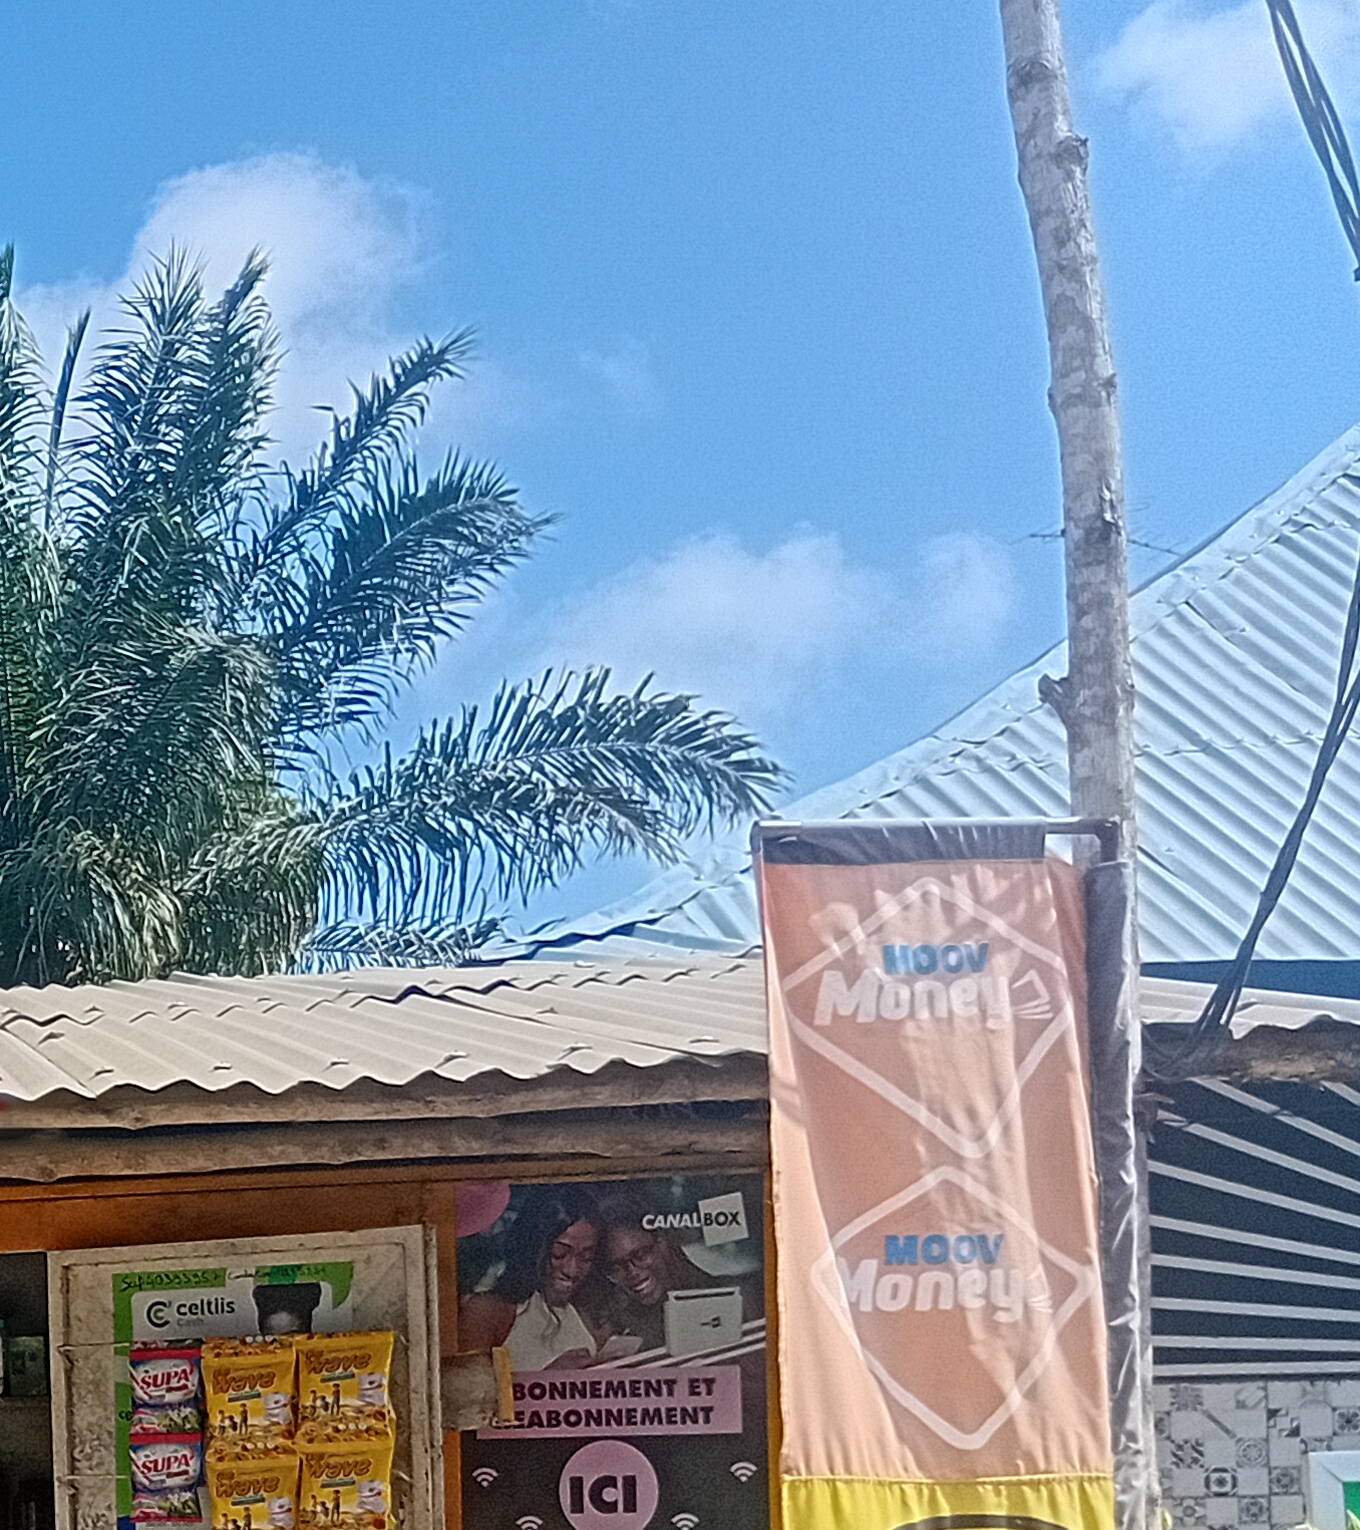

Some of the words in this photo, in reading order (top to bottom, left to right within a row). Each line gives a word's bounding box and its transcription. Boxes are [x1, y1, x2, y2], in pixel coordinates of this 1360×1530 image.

[883, 943, 989, 975] MOOV
[813, 969, 1011, 1031] Money
[884, 1233, 1003, 1266] MOOV
[835, 1258, 1026, 1323] Money
[141, 1368, 190, 1389] SUPA
[512, 1378, 677, 1401] BONNEMENT
[688, 1378, 716, 1397] ET
[493, 1406, 714, 1430] EABONNEMENT
[141, 1453, 191, 1475] SUPA
[569, 1475, 637, 1515] ICI
